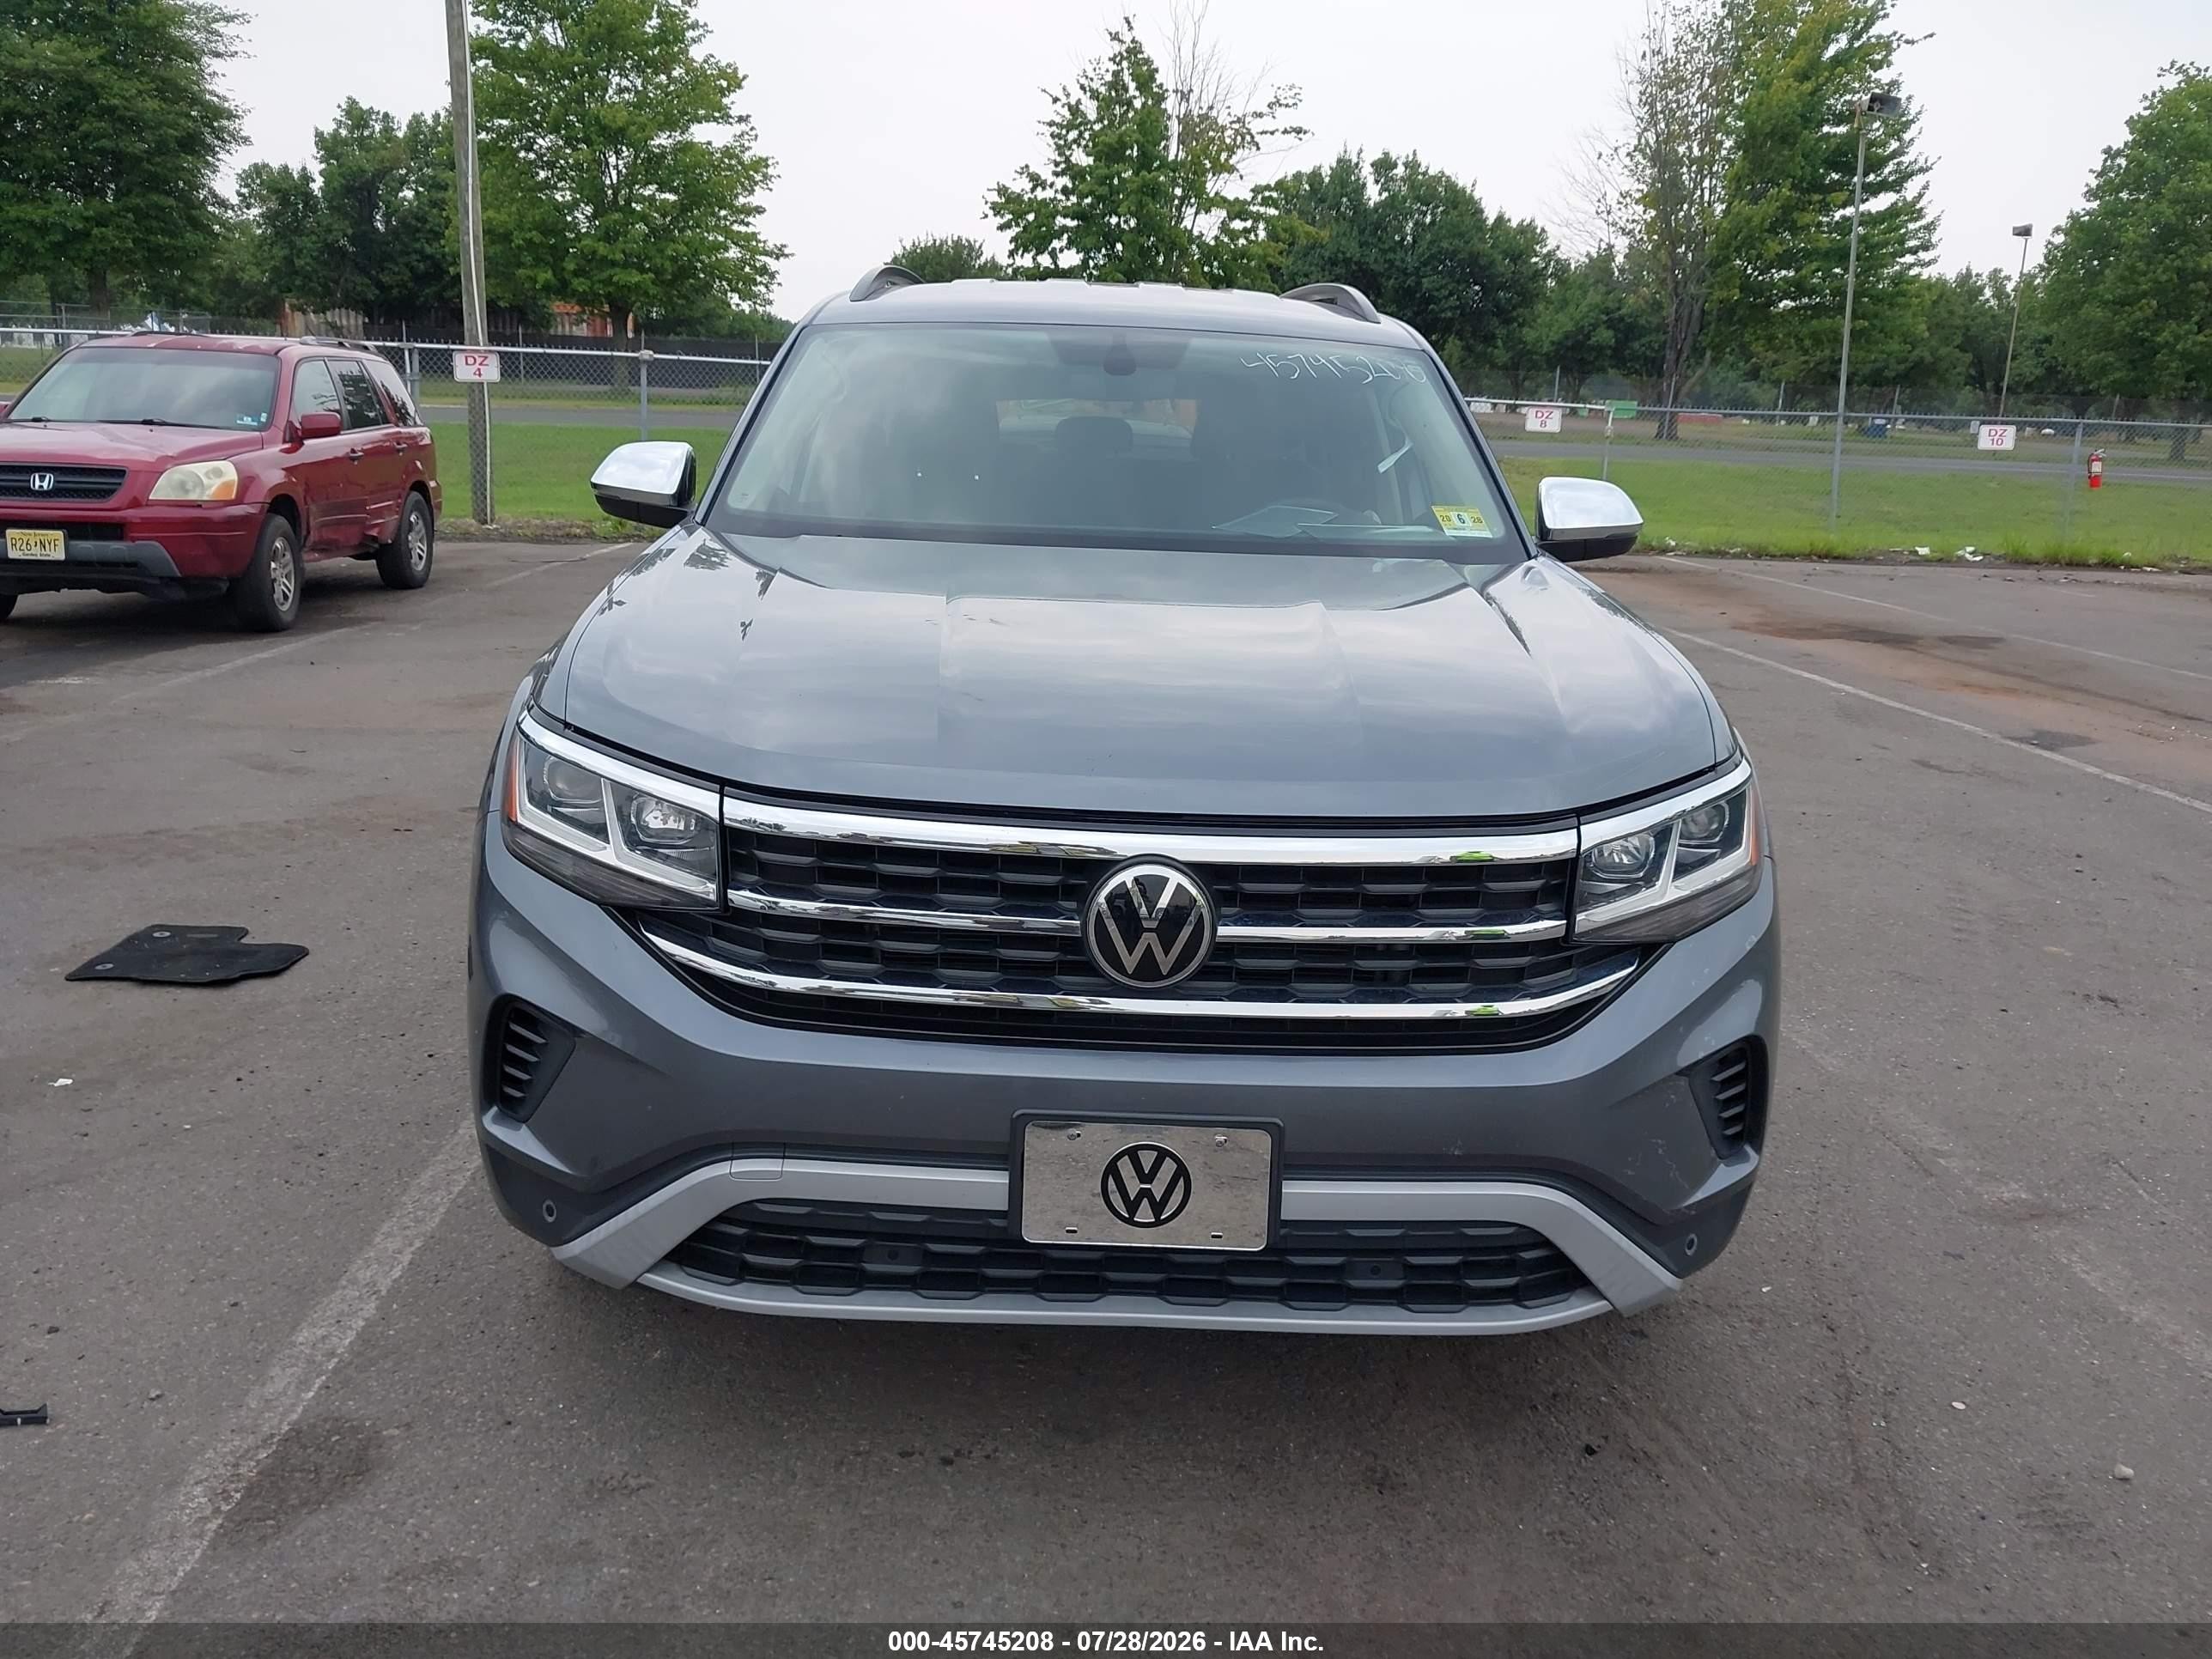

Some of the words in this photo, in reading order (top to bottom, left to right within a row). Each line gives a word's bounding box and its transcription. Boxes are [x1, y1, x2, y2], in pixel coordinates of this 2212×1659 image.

[465, 356, 489, 366] DZ
[473, 368, 483, 378] 4
[1534, 410, 1553, 419] DZ
[1540, 420, 1547, 428] 8
[1988, 428, 2008, 438] DZ
[1990, 438, 2004, 447] 10
[1456, 514, 1466, 524] 6
[10, 537, 33, 552] R26
[40, 538, 60, 553] NYF
